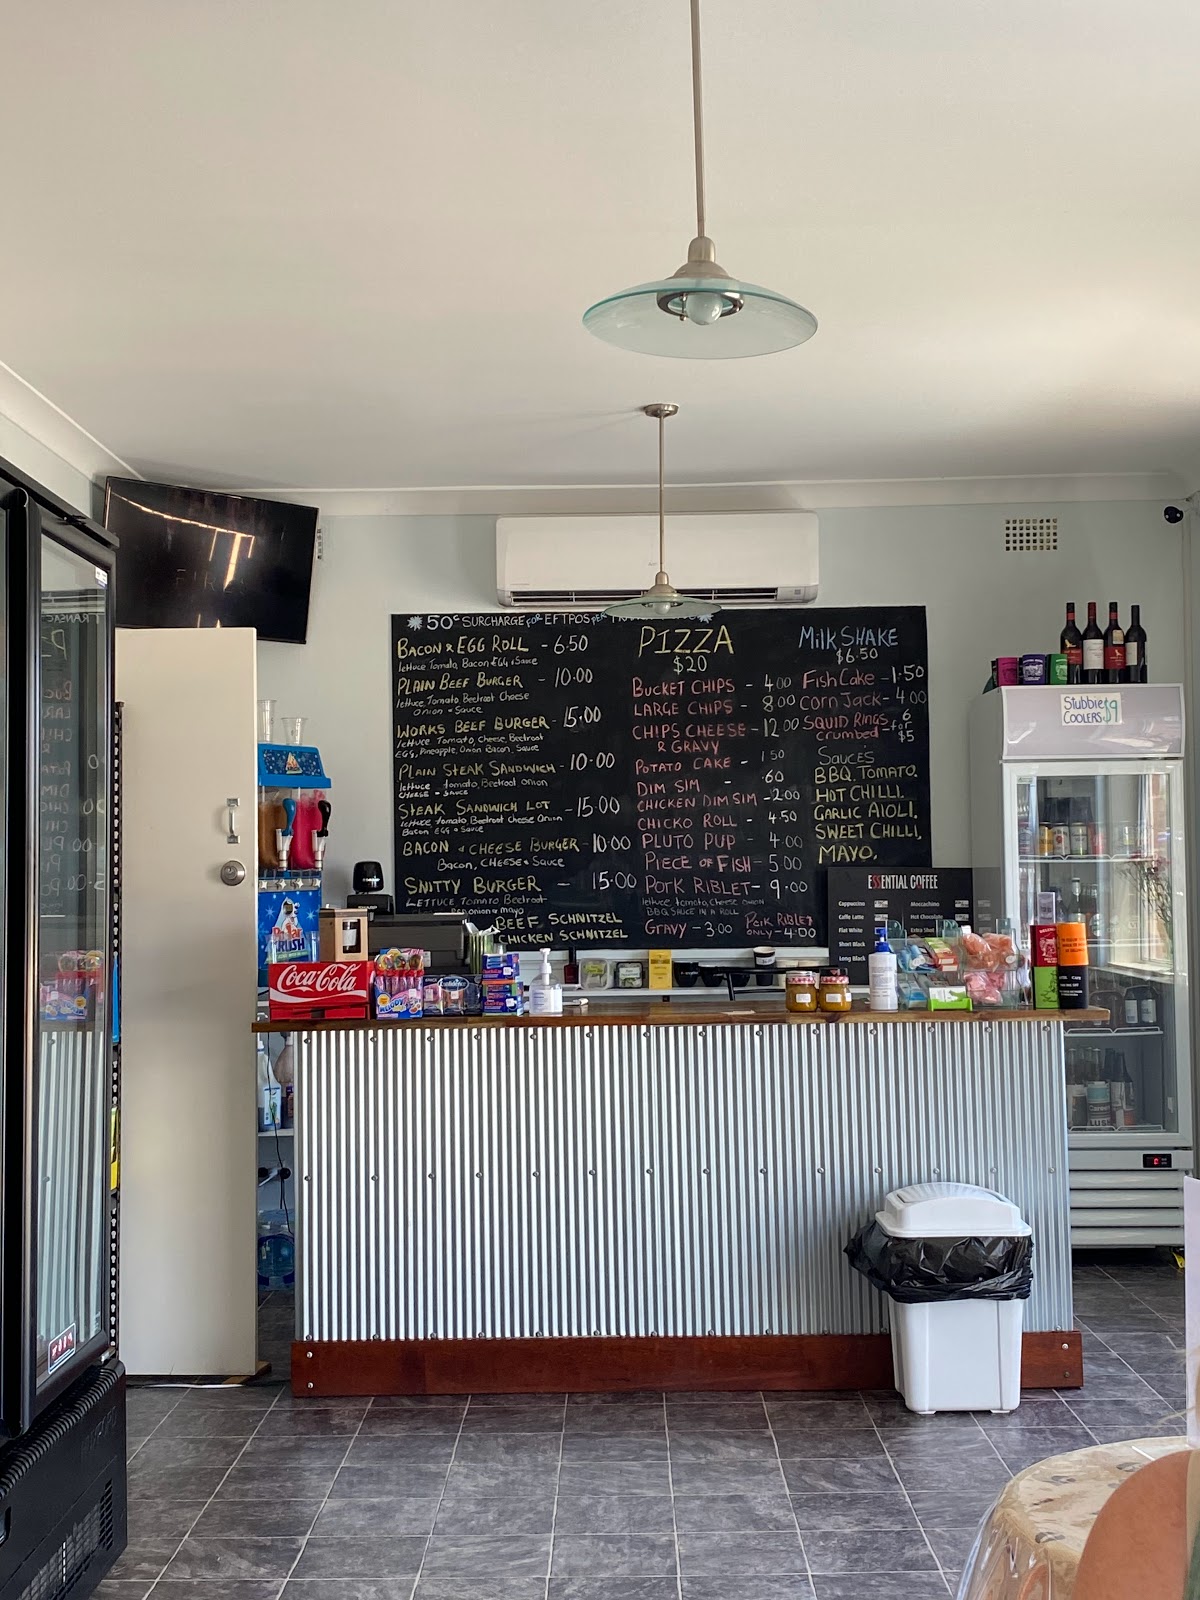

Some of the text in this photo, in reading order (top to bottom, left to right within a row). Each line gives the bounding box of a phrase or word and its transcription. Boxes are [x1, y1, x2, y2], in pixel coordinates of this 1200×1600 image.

[462, 615, 525, 626] SURCHARGE
[526, 614, 543, 628] FOR
[544, 614, 590, 625] EFTPOS
[591, 612, 607, 625] PER
[638, 625, 734, 657] PIZZA
[841, 626, 898, 647] SHAKE
[397, 638, 441, 659] BACON
[457, 636, 485, 653] EGG
[492, 635, 529, 651] ROLL
[554, 635, 588, 655] 6.50
[836, 648, 878, 664] $6.50
[674, 656, 707, 675] $20
[892, 664, 924, 683] 1.50
[397, 667, 593, 696] PLAIN BEEF BURGER 10.00
[632, 677, 685, 697] BUCKET
[691, 678, 735, 694] CHIPS
[634, 701, 679, 716] LARGE
[688, 700, 733, 715] CHIPS
[841, 692, 881, 708] Jack
[902, 709, 911, 721] 6
[1063, 711, 1102, 723] COOLERS
[1064, 696, 1118, 723] Stubbie $9
[397, 705, 601, 739] WORKS BEEF BURGER 15.00
[803, 712, 888, 730] SQUID RINGS
[890, 720, 912, 730] for
[632, 723, 680, 740] CHIPS
[686, 723, 746, 737] CHEESE
[816, 727, 878, 741] crumbed
[898, 730, 914, 742] $5
[671, 740, 720, 754] GRAVY
[399, 752, 615, 779] PLAIN STEAK SANDWICH 10.00
[635, 757, 731, 775] POTATO CAKE
[637, 781, 666, 797] DIM
[674, 779, 700, 792] SIM
[816, 788, 846, 802] HOT
[398, 796, 620, 819] STEAK SANDWICH LOT 15.00
[637, 798, 696, 812] CHICKEN
[703, 795, 729, 807] DIM
[733, 793, 758, 806] SIM
[637, 810, 797, 831] CHICKO ROLL 4.50
[814, 804, 861, 821] GARLIC
[815, 823, 864, 840] SWEET
[402, 833, 631, 856] BACON CHEESE BURGER 10.00
[642, 833, 694, 849] PLUTO
[705, 832, 736, 850] PUP
[645, 851, 692, 870] PIECE
[716, 855, 751, 873] FISH
[404, 871, 637, 895] SNITTY BURGER 15.00
[694, 877, 750, 896] RIBLET
[770, 879, 808, 900] 9.00
[868, 874, 938, 889] ESSENTIAL COFFEE
[646, 907, 669, 916] BBQ
[719, 907, 739, 915] ROLL
[495, 913, 623, 930] BEEF SCHNITZEL
[705, 922, 732, 937] 3.00
[498, 928, 628, 945] CHICKEN SCHNITZEL
[746, 928, 772, 938] ONLY
